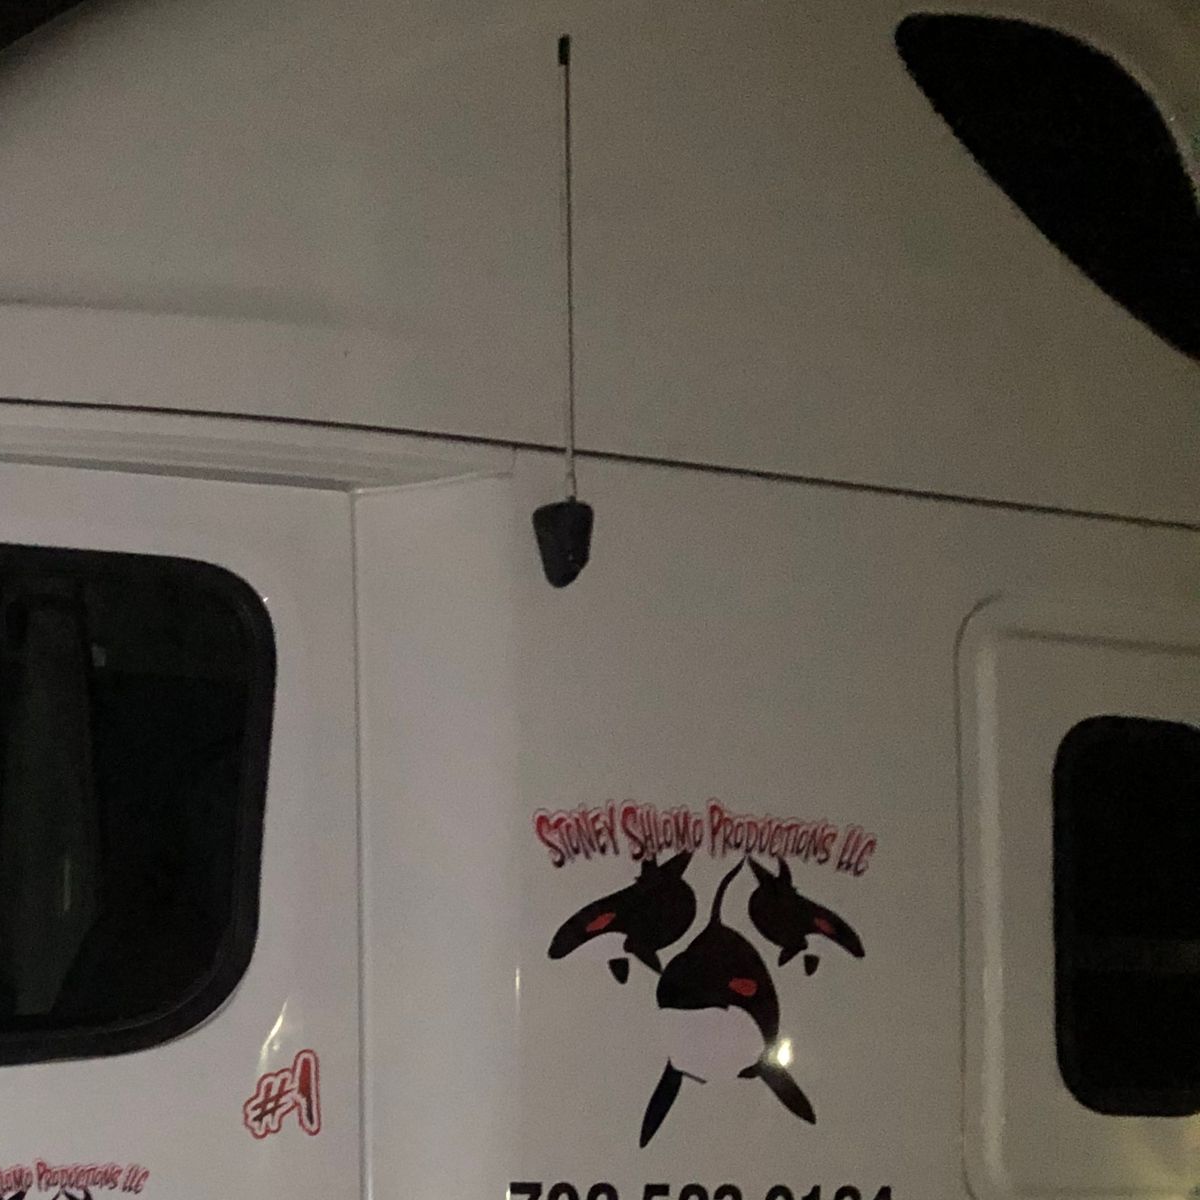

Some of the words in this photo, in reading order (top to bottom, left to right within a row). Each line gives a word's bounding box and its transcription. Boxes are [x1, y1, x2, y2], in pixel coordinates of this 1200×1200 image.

[535, 800, 620, 869] STONEY
[619, 799, 705, 862] SHLOMO
[707, 798, 839, 865] PRODUCTIONS
[834, 823, 878, 878] LLC
[243, 1048, 322, 1139] #1
[35, 1158, 123, 1193] PRODUCTIONS
[120, 1164, 150, 1195] LLC
